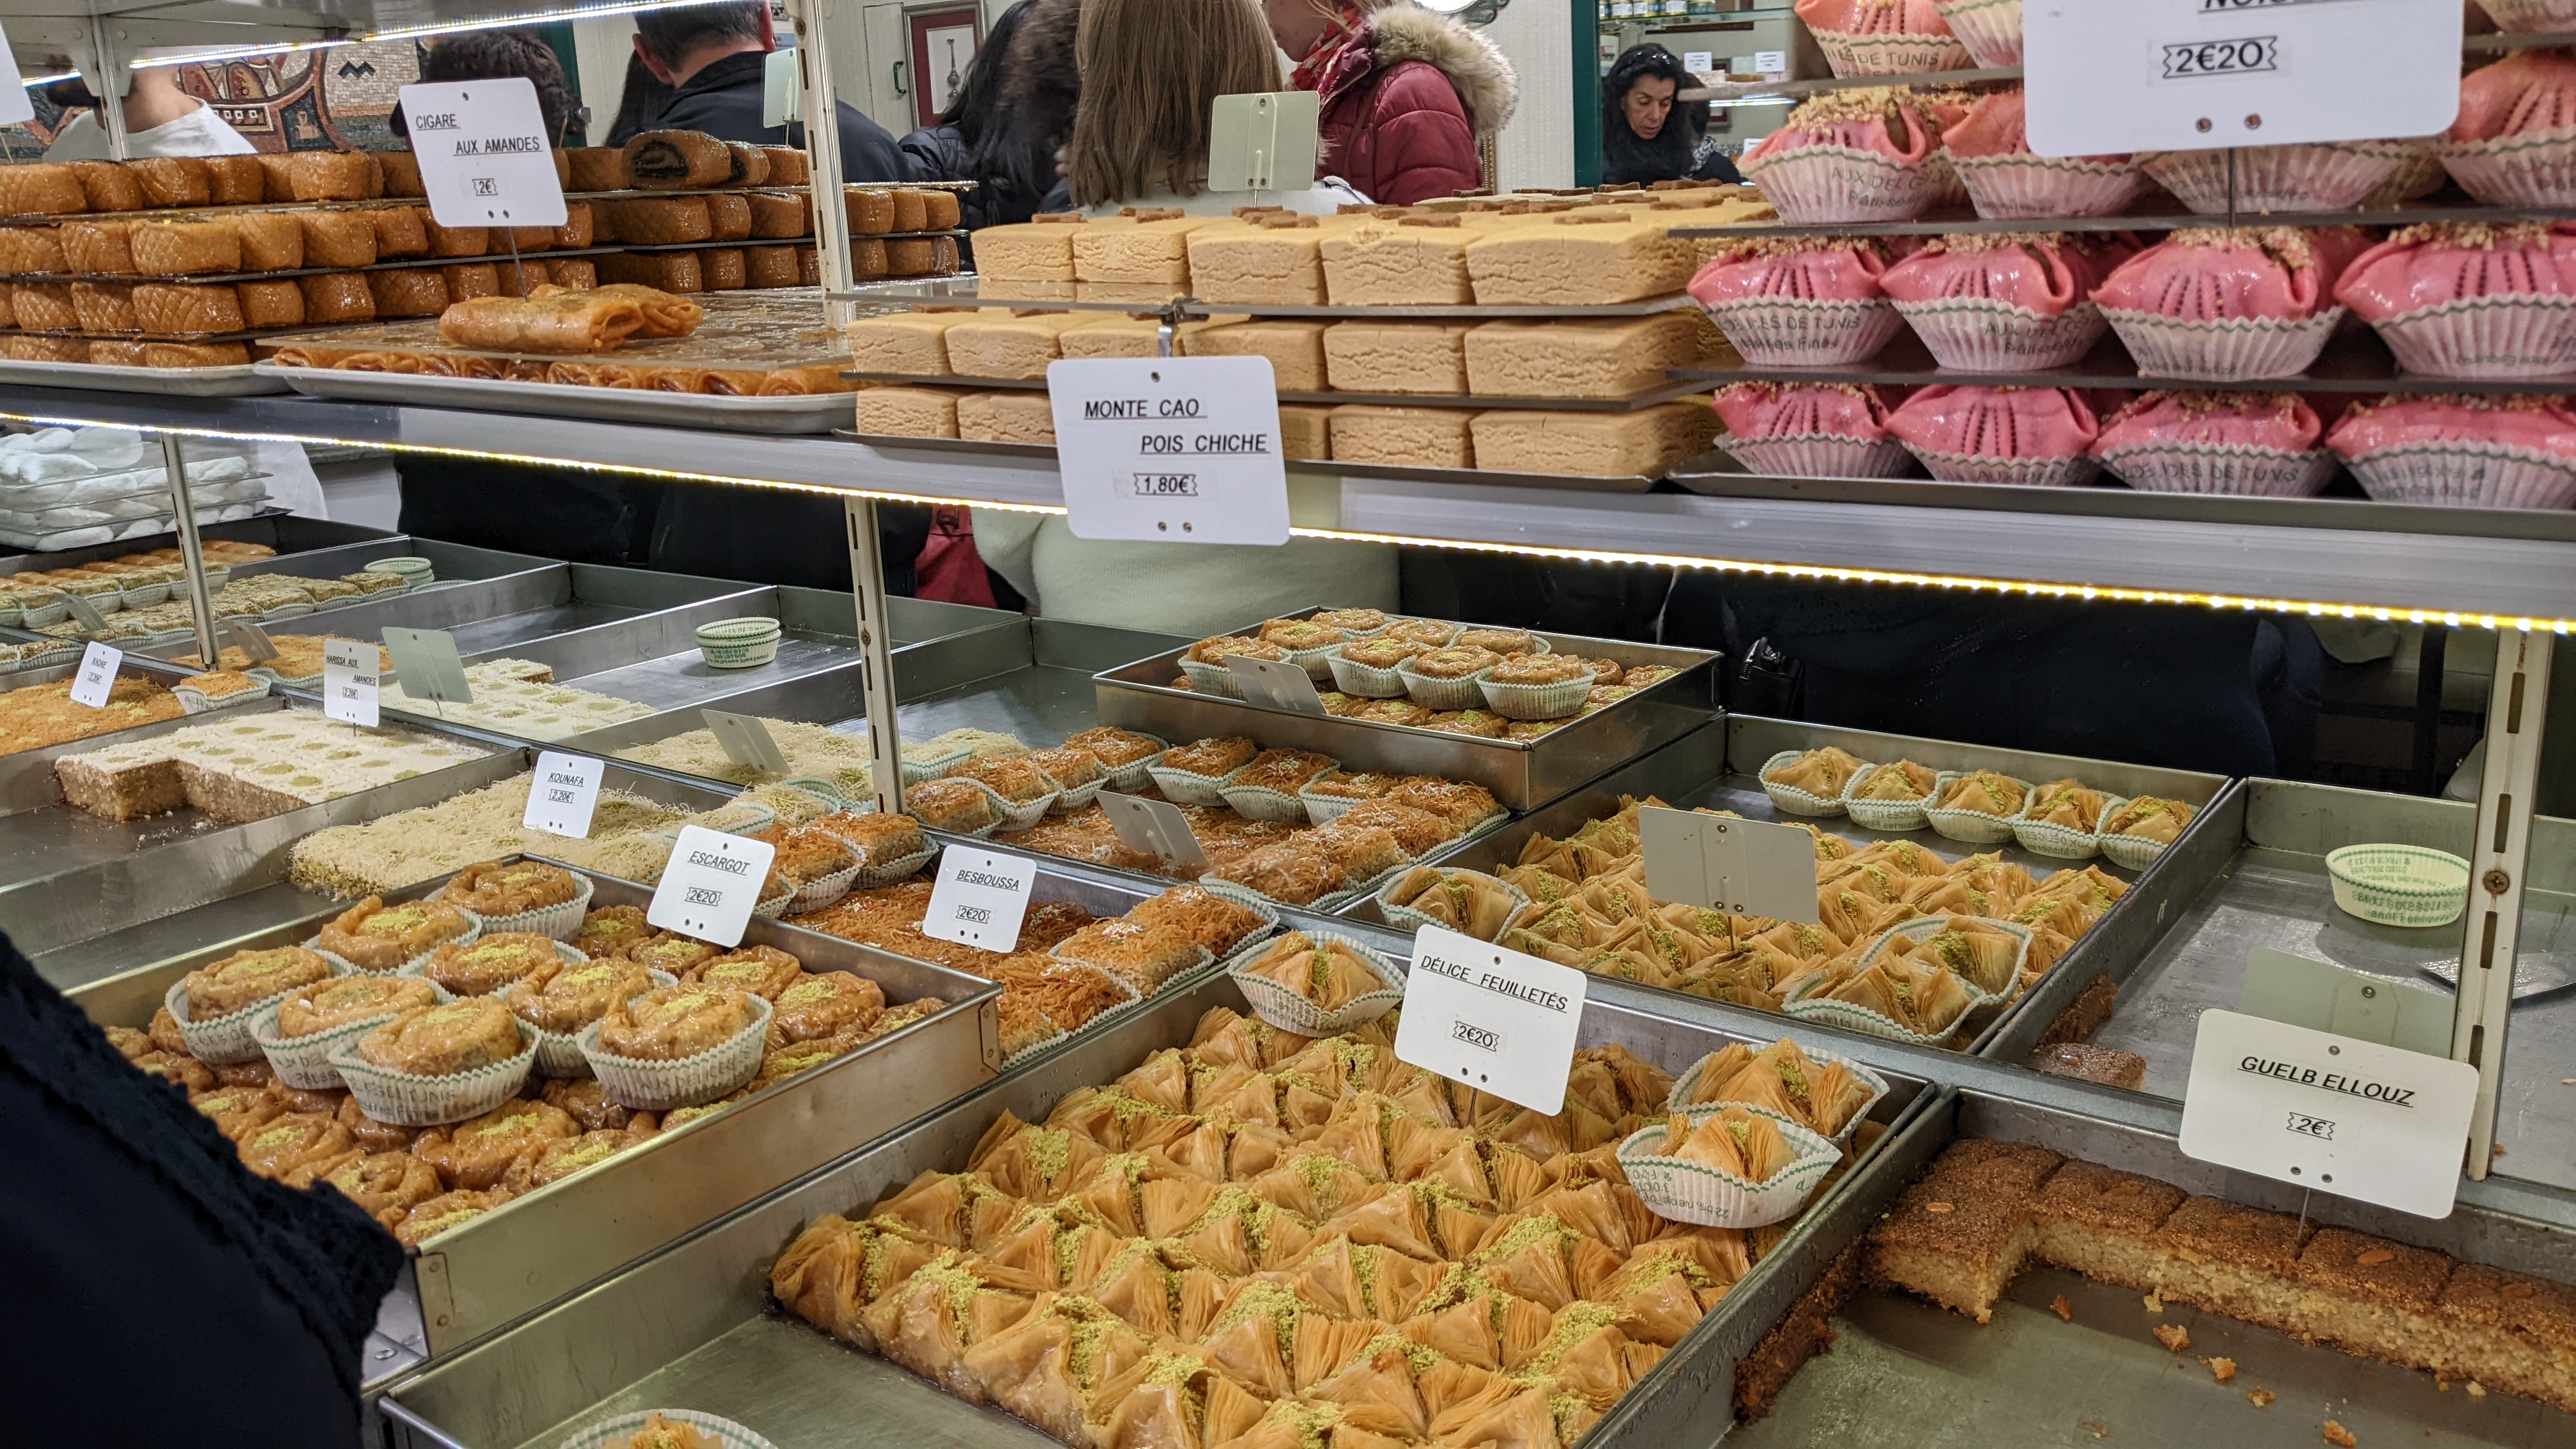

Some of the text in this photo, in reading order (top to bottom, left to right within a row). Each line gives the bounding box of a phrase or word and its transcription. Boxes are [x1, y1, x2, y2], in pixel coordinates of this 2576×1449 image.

[1885, 52, 1940, 66] TUNIS
[2175, 40, 2264, 73] 2€20
[415, 114, 457, 128] CIGARE
[456, 136, 540, 155] AUX AMANDES
[479, 180, 492, 194] 2€
[1085, 398, 1200, 418] MONTE CAO
[1141, 434, 1269, 453] POIS CHICHE
[1144, 476, 1189, 495] 1,80€
[326, 655, 358, 667] HARISSA AUX
[353, 675, 376, 686] AMANDES
[549, 772, 584, 786] KOUNAFA
[551, 791, 572, 802] 2,20€
[689, 850, 751, 873] ESCARGOT
[956, 870, 1020, 890] BESBOUSSA
[689, 889, 717, 904] 2€20
[960, 907, 986, 921] 2€20
[1420, 955, 1568, 1010] DÉLICE FEUILLETÉS
[1457, 1025, 1494, 1047] 2€20
[2241, 1056, 2415, 1105] GUELB ELLOUZ
[2296, 1117, 2327, 1135] 2€
